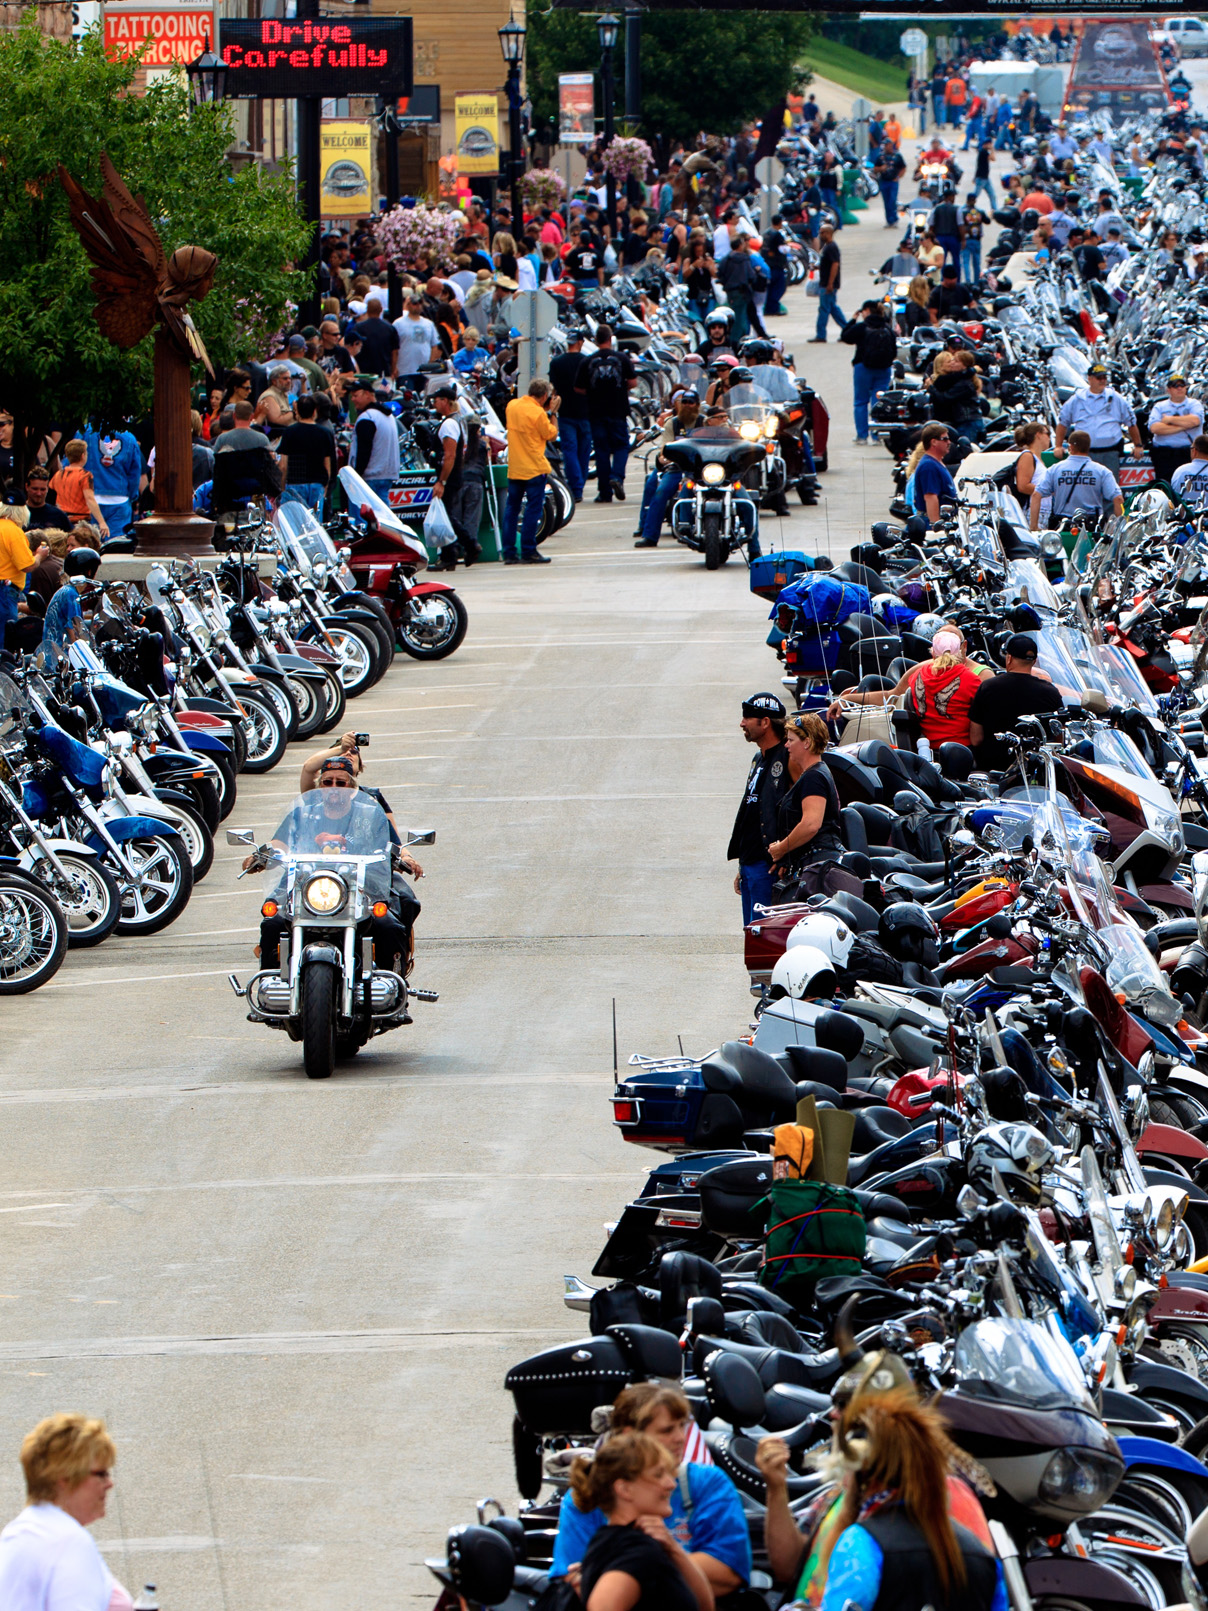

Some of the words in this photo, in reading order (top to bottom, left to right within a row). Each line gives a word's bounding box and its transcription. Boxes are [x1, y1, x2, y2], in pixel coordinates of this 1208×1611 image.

[107, 14, 211, 38] TATTOOING
[261, 20, 352, 44] Drive
[116, 40, 203, 63] PIERCING
[223, 43, 388, 67] Carefully
[458, 106, 496, 115] WELCOME
[322, 136, 368, 147] WELCOME
